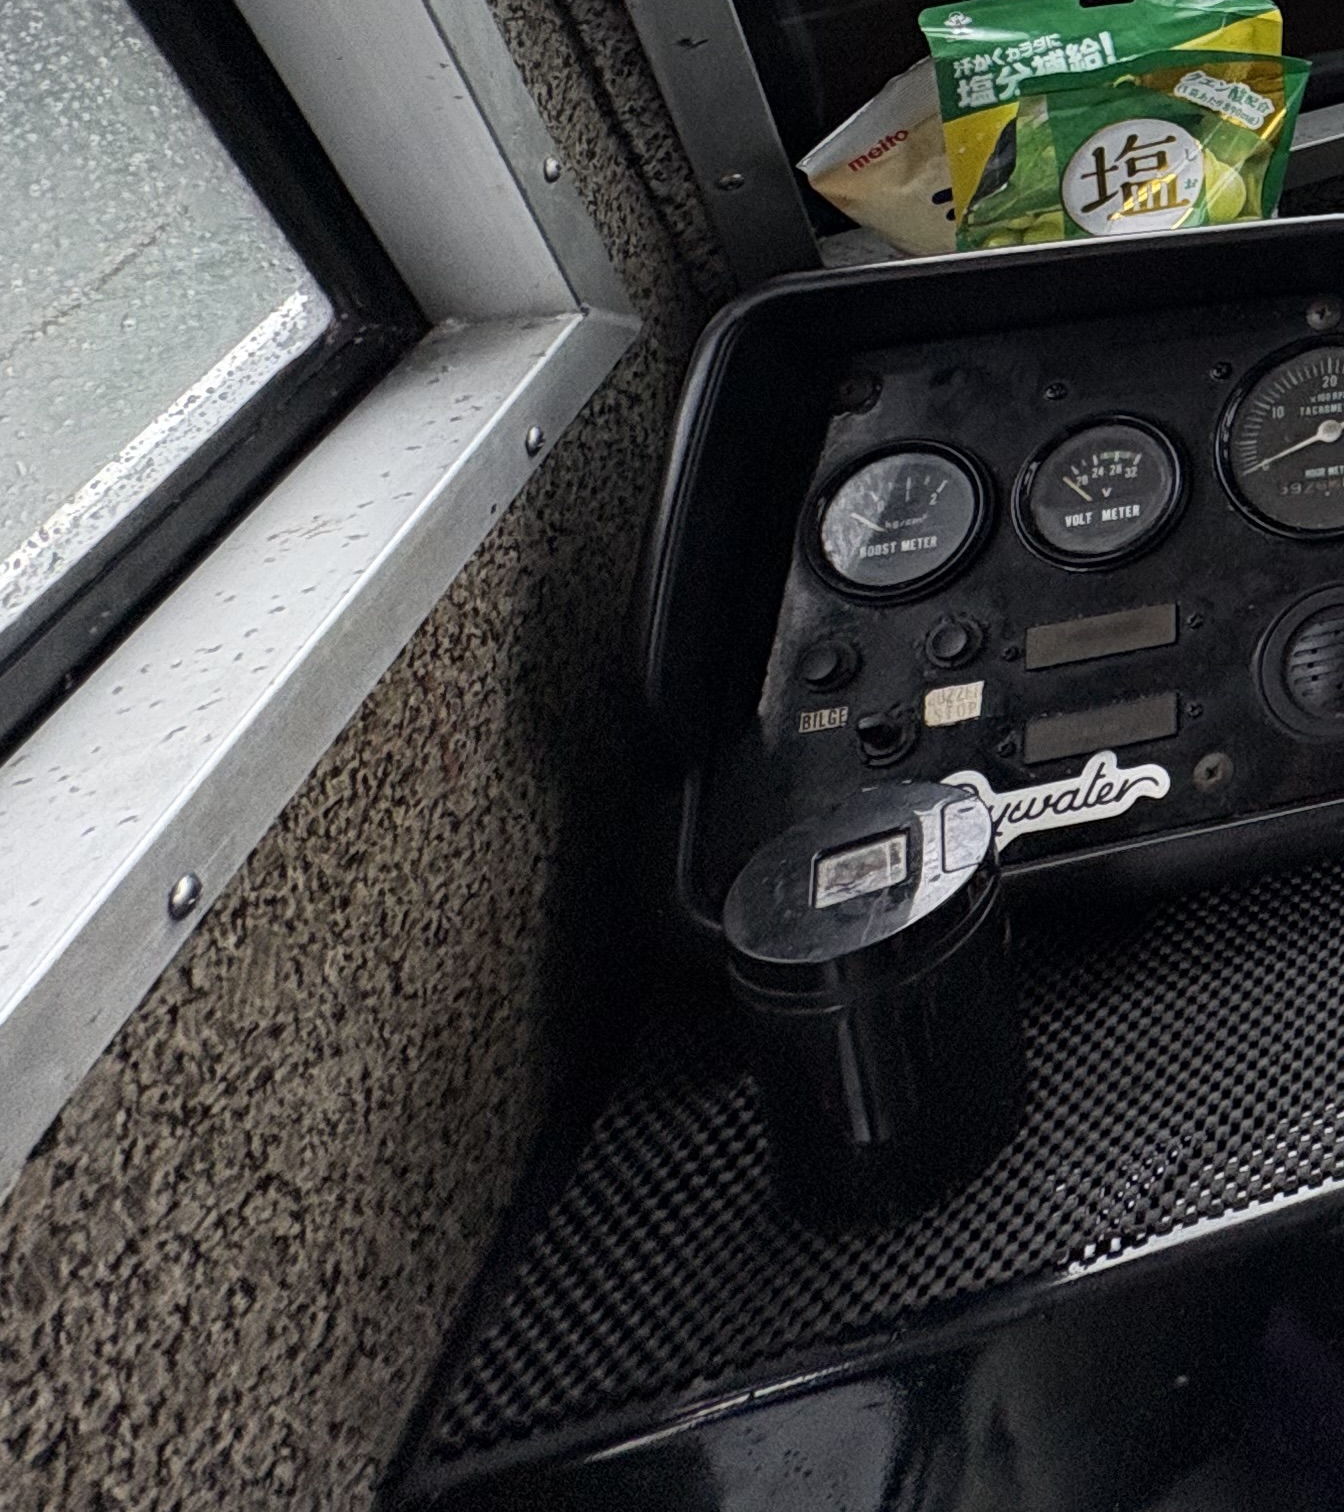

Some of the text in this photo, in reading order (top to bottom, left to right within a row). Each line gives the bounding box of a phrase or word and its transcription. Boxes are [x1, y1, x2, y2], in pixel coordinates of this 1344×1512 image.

[953, 33, 1063, 79] 汗かくカラダに
[1186, 73, 1270, 115] クエン酸配合
[848, 130, 909, 172] meito
[1080, 134, 1190, 221] 塩
[1184, 148, 1199, 190] しお
[1322, 375, 1338, 388] 20
[1272, 406, 1285, 419] 10
[1091, 466, 1105, 479] 24
[1109, 464, 1123, 476] 28
[1124, 466, 1138, 478] 32
[928, 492, 939, 506] 2
[1065, 504, 1140, 528] VOLT METER
[859, 535, 938, 559] BOOST METER
[802, 708, 847, 731] BILGE
[934, 700, 977, 721] STOP
